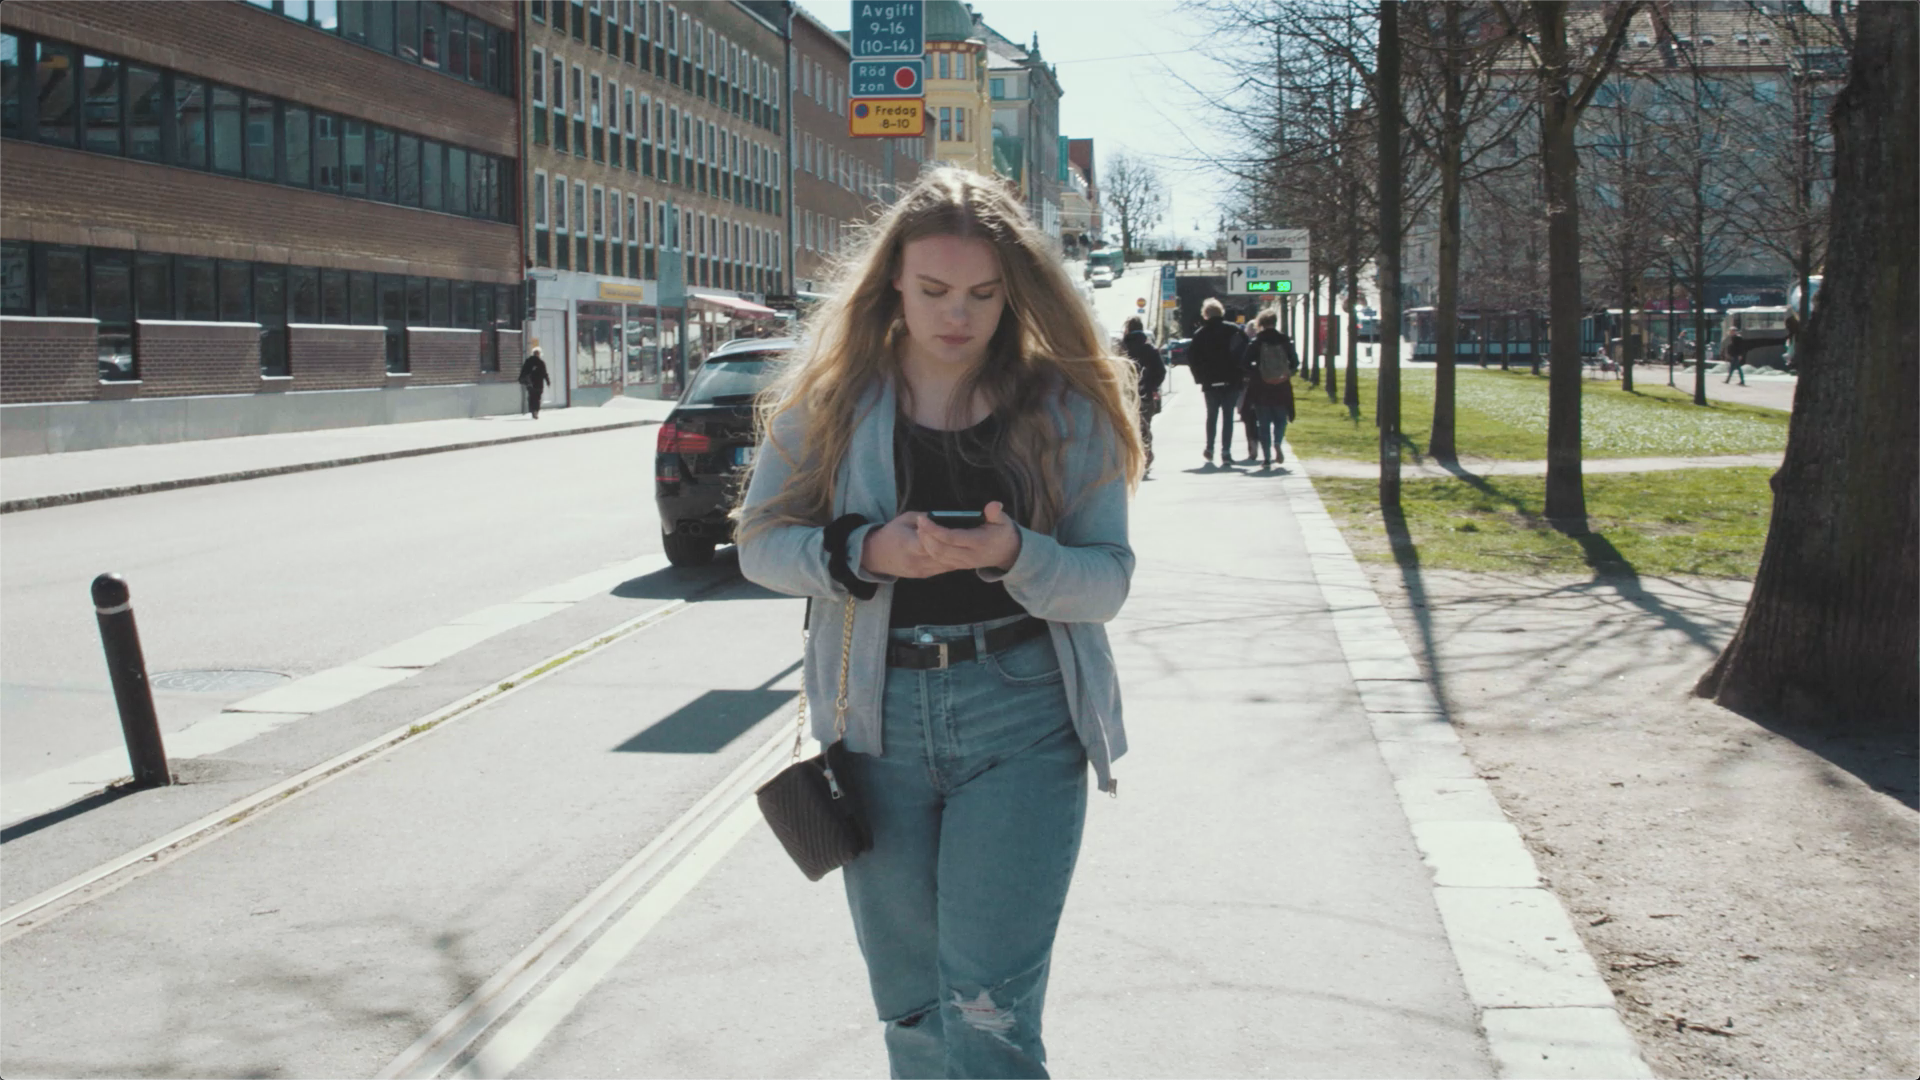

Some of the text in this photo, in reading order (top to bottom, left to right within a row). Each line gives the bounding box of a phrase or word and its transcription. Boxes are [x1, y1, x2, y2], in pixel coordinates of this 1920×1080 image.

[861, 4, 914, 19] Avgift
[870, 22, 905, 34] 9-16
[860, 39, 915, 54] (10-14)
[859, 66, 886, 77] Röd
[859, 83, 885, 92] zon
[875, 105, 917, 117] Fredag
[882, 119, 910, 129] 8-10
[1260, 268, 1290, 276] Kronan
